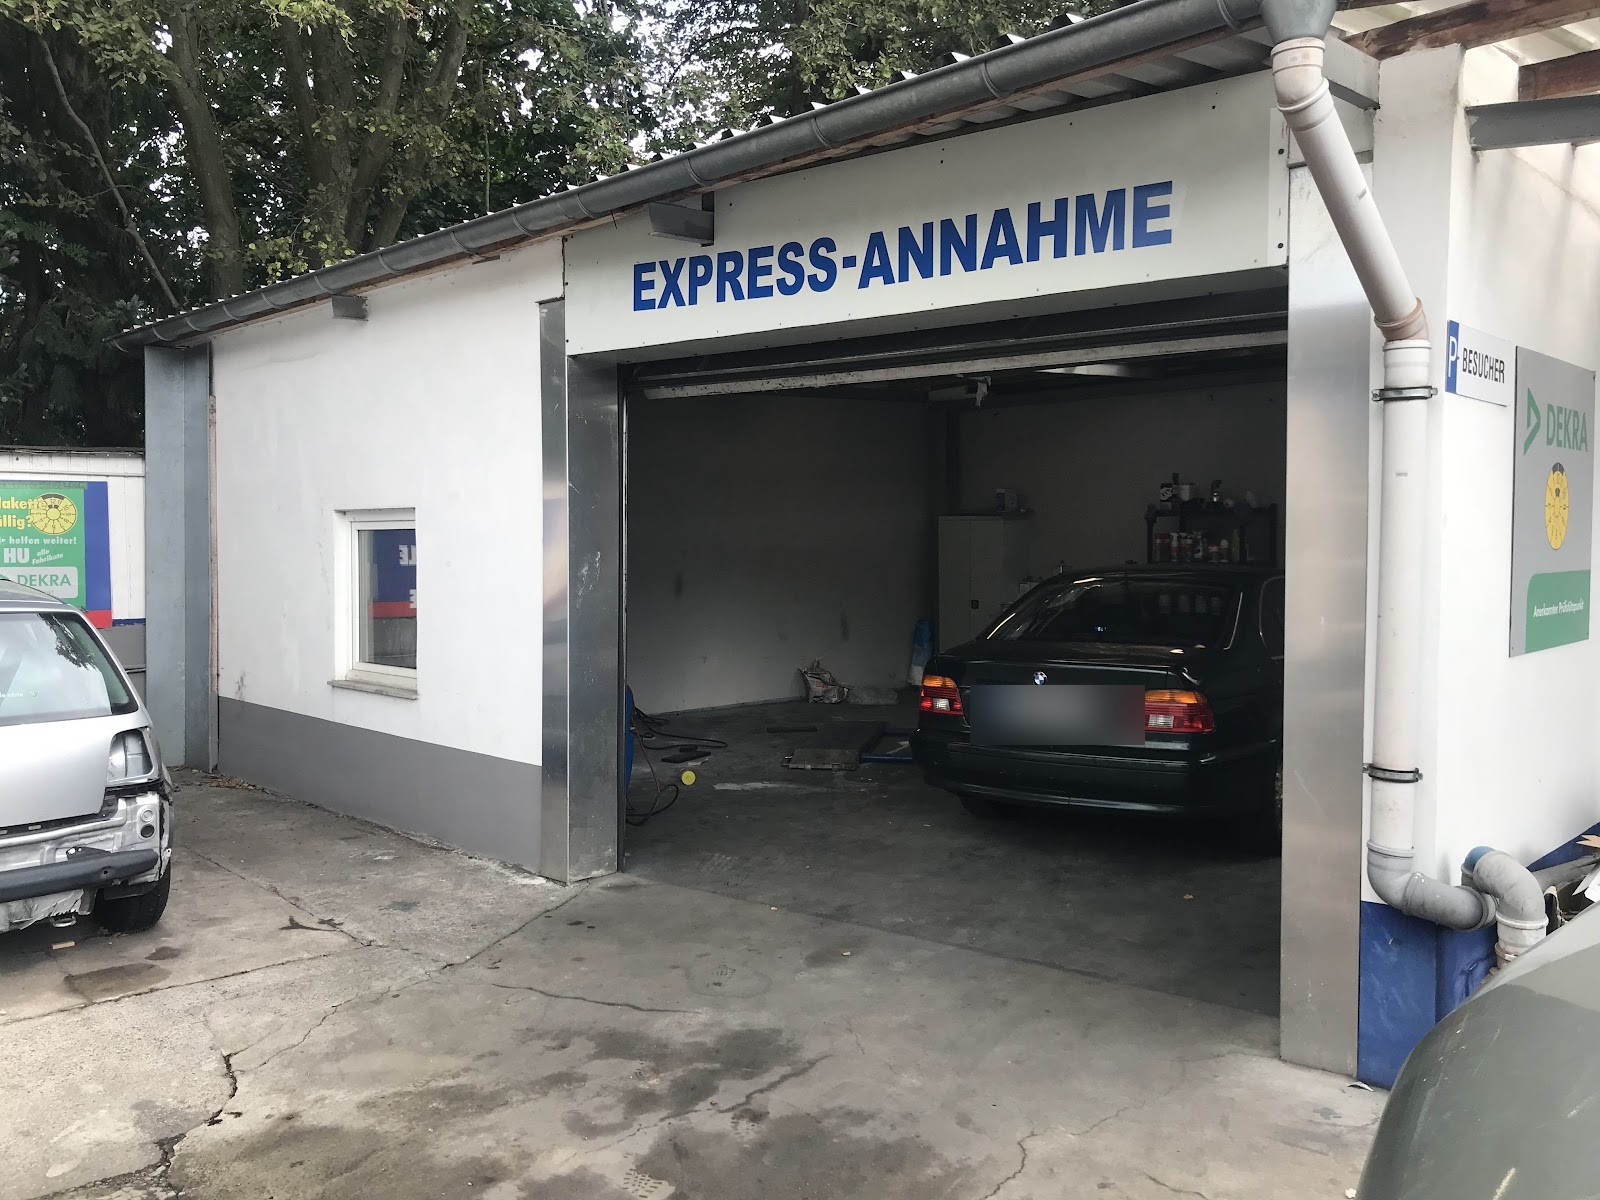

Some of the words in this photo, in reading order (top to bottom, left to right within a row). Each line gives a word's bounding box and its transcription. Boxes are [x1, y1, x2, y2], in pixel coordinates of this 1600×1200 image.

[633, 181, 1173, 312] EXPRESS-ANNAHME
[1462, 347, 1505, 384] BESUCHER
[1545, 403, 1588, 453] DEKRA
[9, 535, 40, 545] helfen
[43, 535, 77, 545] weiter!
[3, 547, 30, 564] HU
[36, 548, 50, 557] alle
[17, 573, 72, 587] DEKRA
